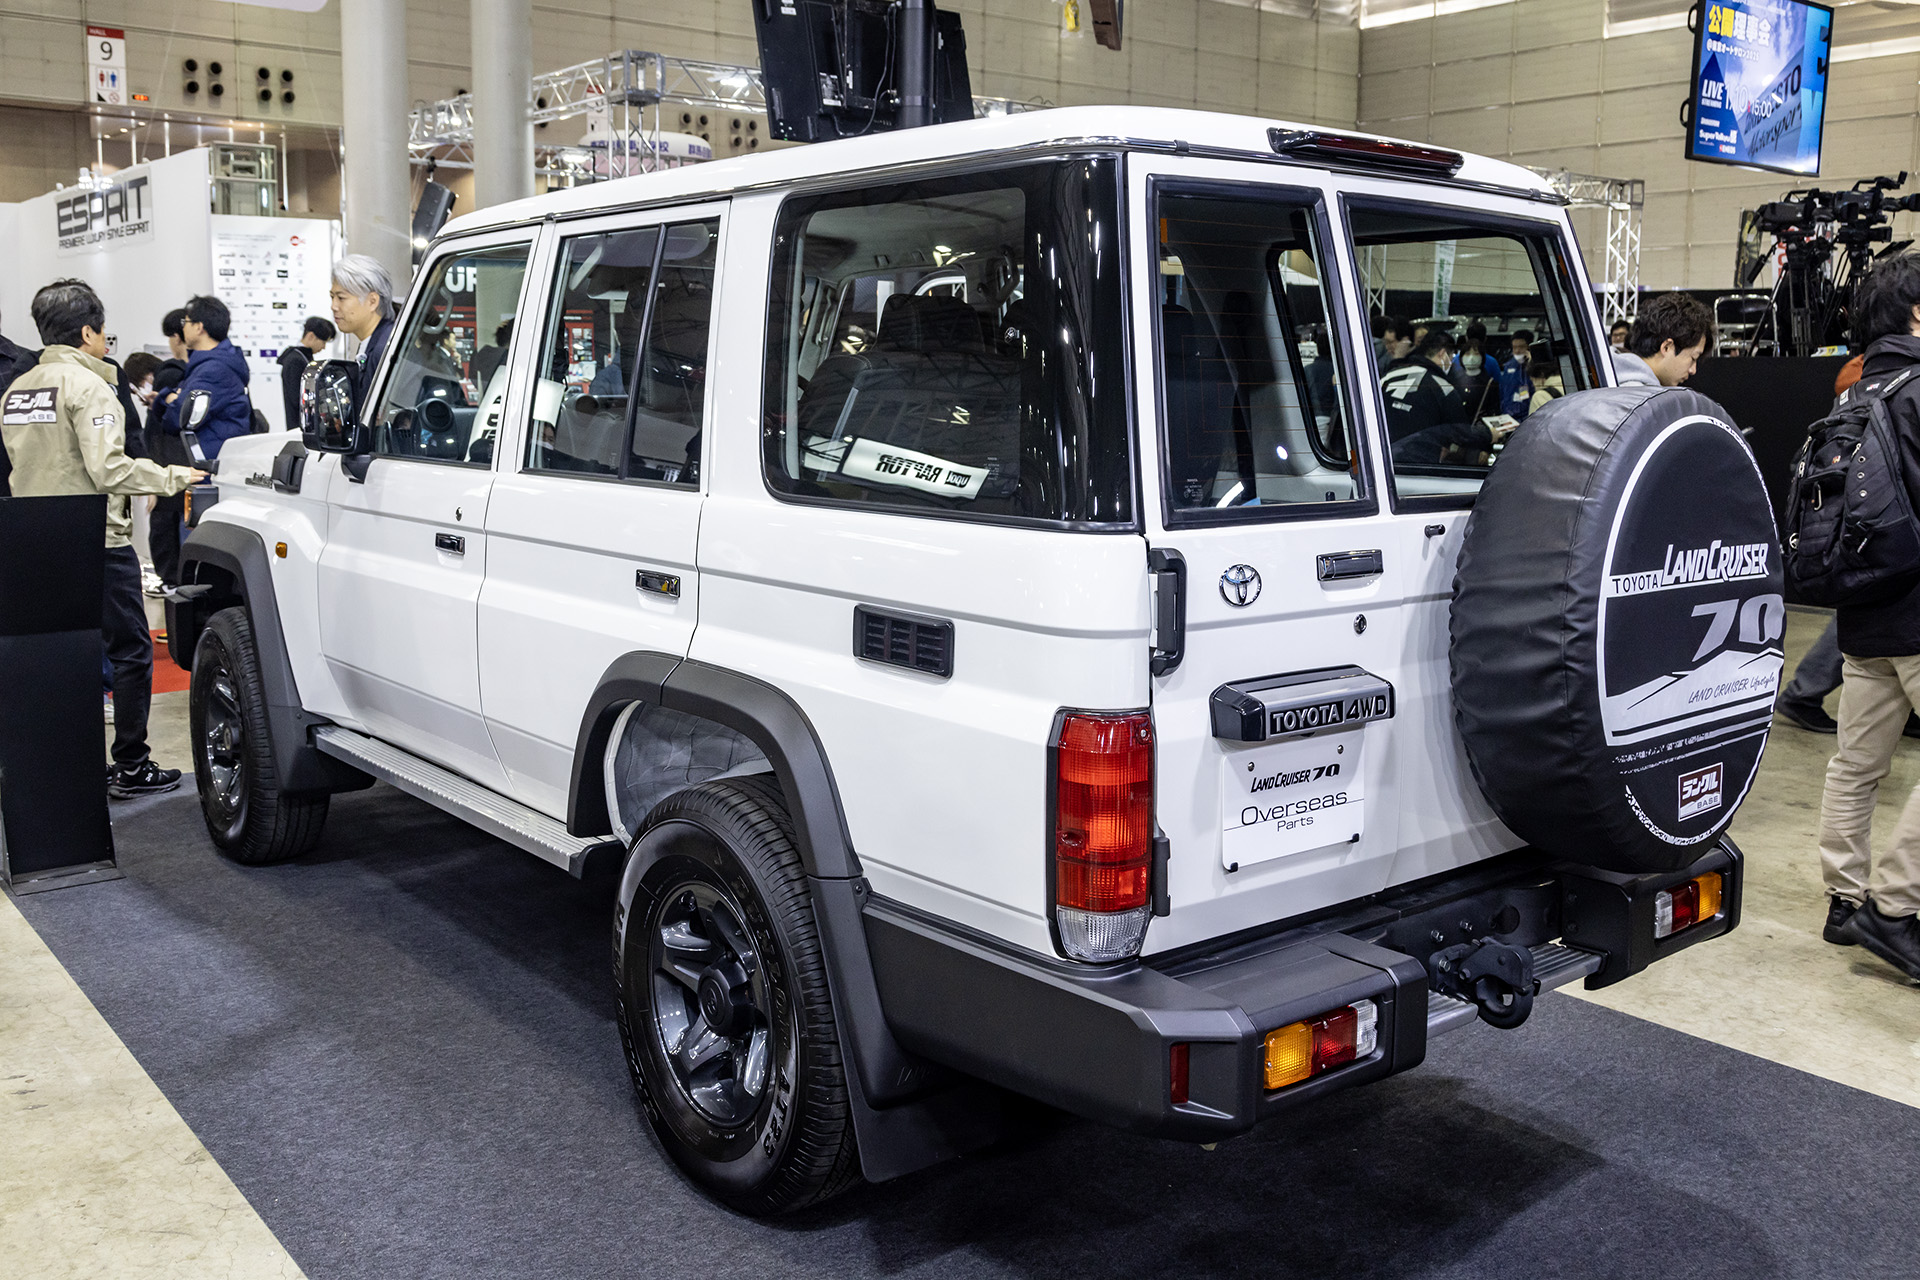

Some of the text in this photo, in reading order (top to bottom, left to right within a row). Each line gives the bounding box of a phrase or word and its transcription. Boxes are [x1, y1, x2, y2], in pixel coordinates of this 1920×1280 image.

[1708, 4, 1771, 47] 公開理事会
[100, 41, 113, 61] 9
[1702, 79, 1725, 100] LIVE
[57, 176, 148, 238] ESPRIT
[107, 226, 124, 240] STYLE
[125, 220, 150, 236] ESPRIT
[6, 391, 53, 410] ランクル
[1612, 574, 1659, 594] TOYOTA
[1691, 593, 1785, 662] 70
[1688, 687, 1713, 704] LAND
[1713, 678, 1749, 701] CRUISER
[1272, 695, 1388, 733] TOYOTA 4WD
[1312, 763, 1341, 782] 70
[1681, 771, 1719, 800] ランクル
[1241, 791, 1348, 826] Overseas
[1697, 795, 1719, 809] BASE
[1276, 816, 1314, 832] Parts
